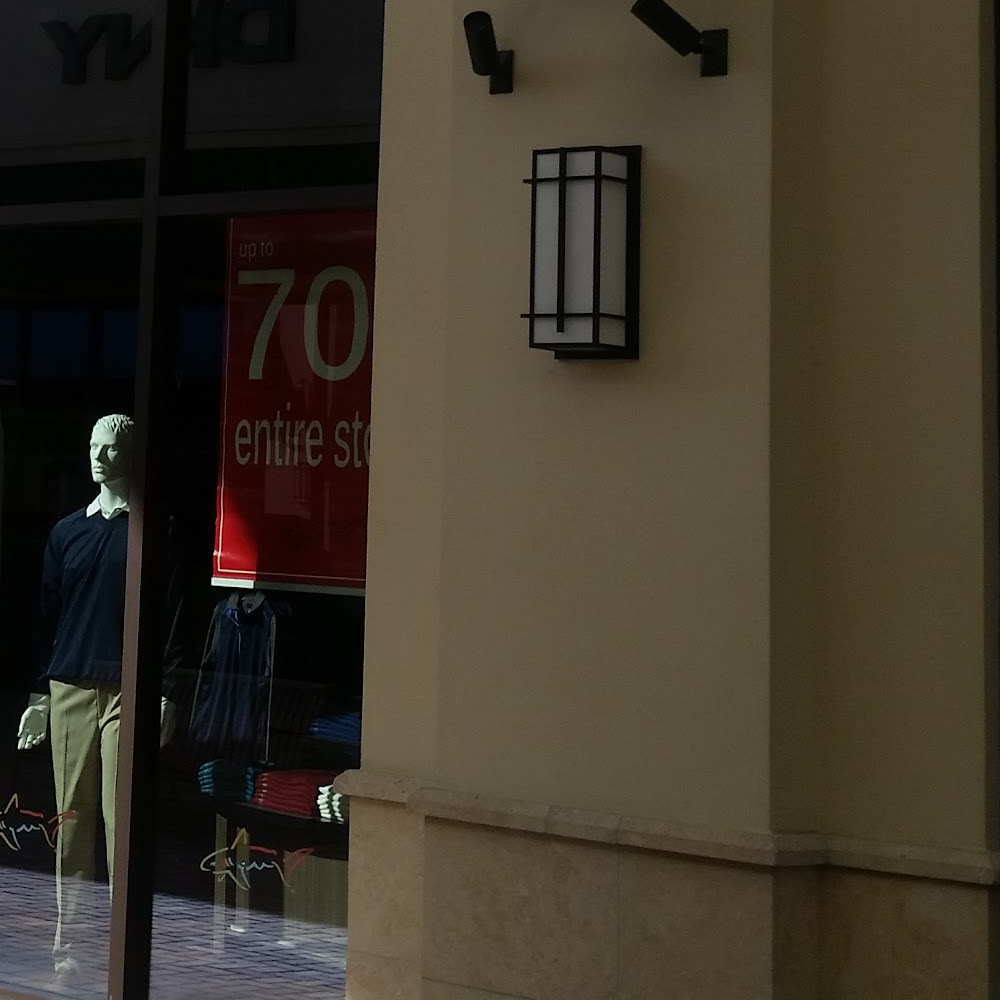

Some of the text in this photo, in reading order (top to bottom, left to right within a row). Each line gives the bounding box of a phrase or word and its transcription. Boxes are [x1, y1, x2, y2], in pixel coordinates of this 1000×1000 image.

[239, 240, 275, 262] up to
[237, 265, 370, 382] 70
[234, 402, 325, 468] entire
